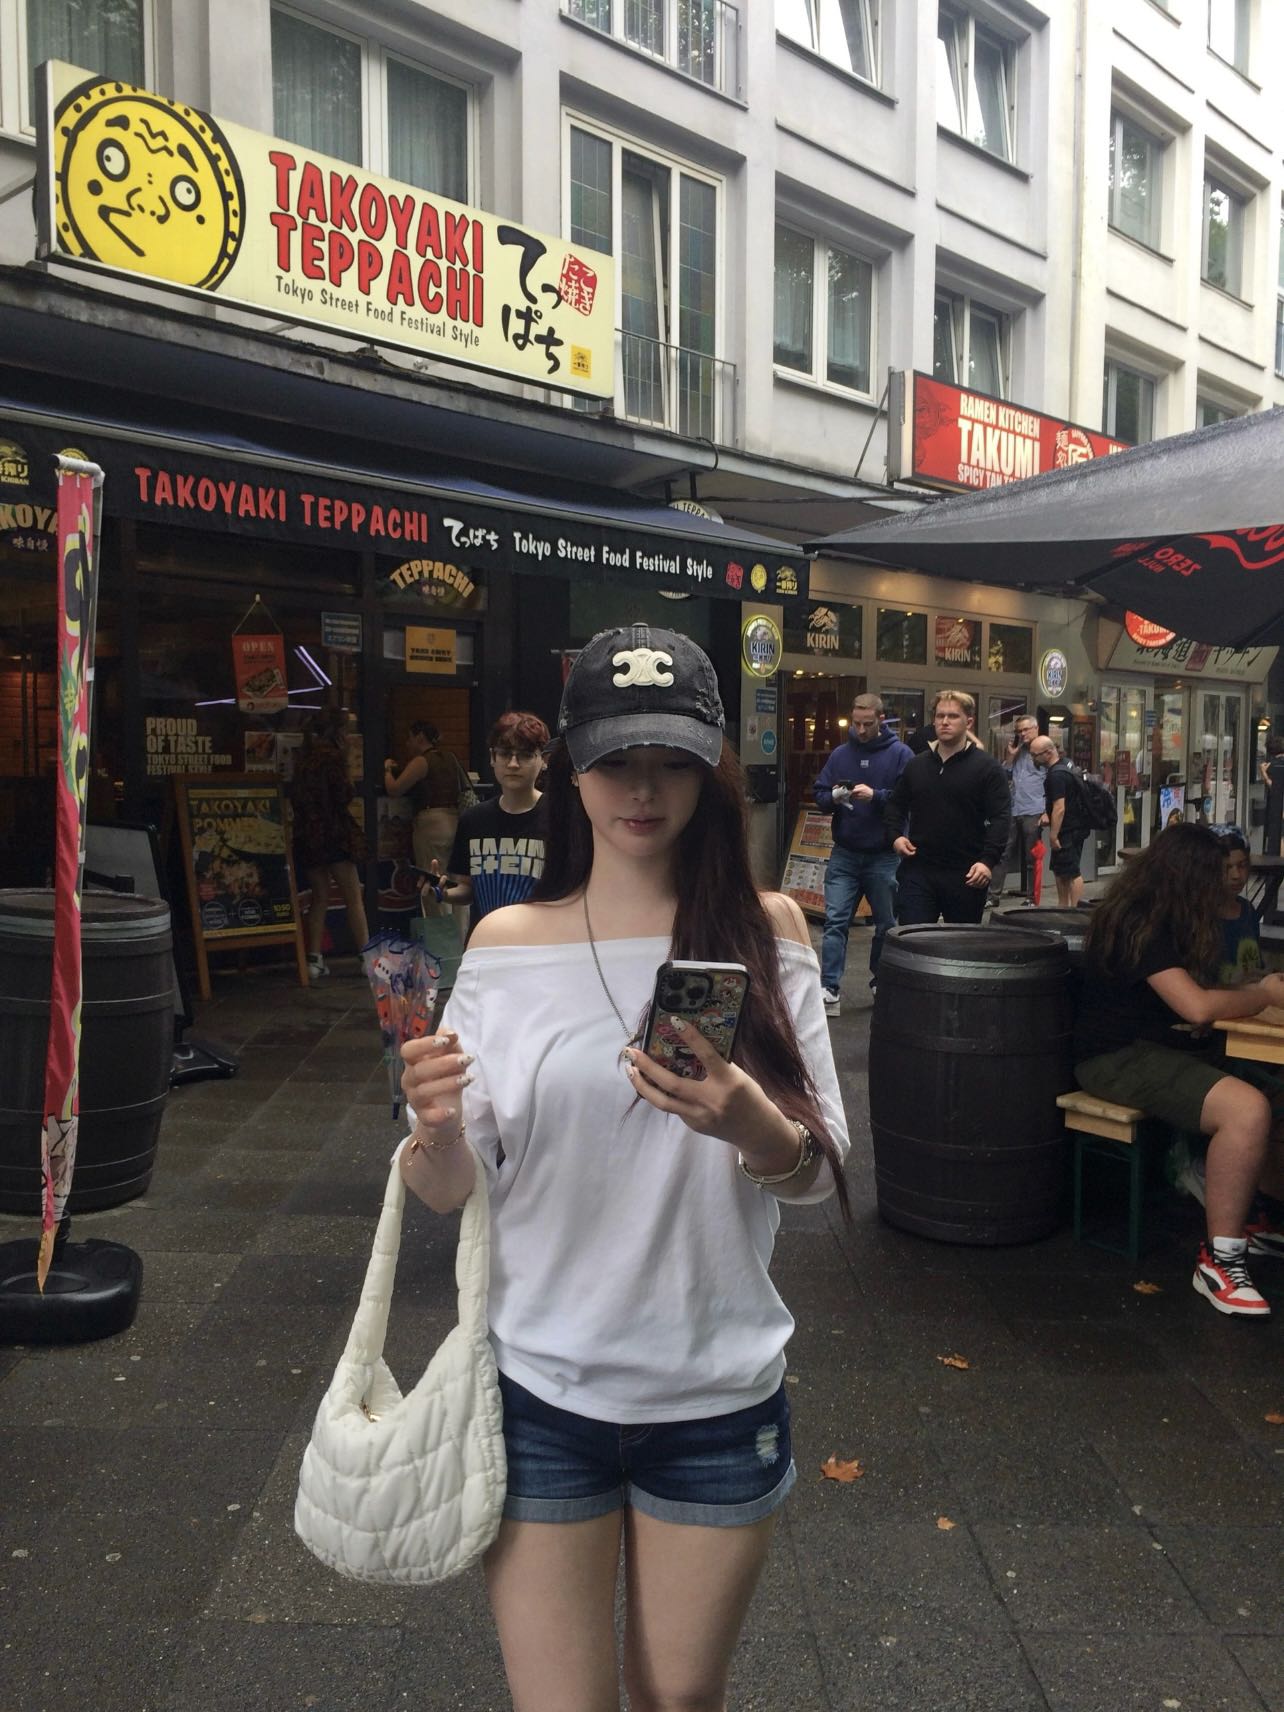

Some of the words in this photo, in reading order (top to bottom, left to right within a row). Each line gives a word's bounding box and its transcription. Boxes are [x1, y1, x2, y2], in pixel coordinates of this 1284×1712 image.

[268, 151, 484, 274] TAKOYAKI
[269, 212, 484, 328] TEPPACHI
[275, 275, 314, 304] Tokyo
[319, 288, 360, 314] Street
[366, 301, 394, 324] Food
[400, 310, 447, 338] Festival
[451, 325, 480, 348] Style
[960, 392, 997, 420] RAMEN
[999, 406, 1041, 439] KITCHEN
[958, 417, 1041, 480] TAKUMI
[958, 463, 986, 487] SPICY
[134, 466, 287, 522] TAKOYAKI
[300, 493, 428, 544] TEPPACHI
[513, 531, 551, 561] Tokyo
[557, 537, 596, 564] Street
[602, 545, 630, 569] Food
[636, 551, 680, 575] Festival
[686, 557, 714, 583] Style
[389, 559, 475, 599] TEPPACHI
[751, 640, 775, 655] KIRIN
[806, 632, 840, 650] KIRIN
[945, 647, 971, 662] KIRIN
[146, 716, 198, 735] PROUD
[147, 735, 166, 753] OF
[168, 735, 214, 753] TASTE
